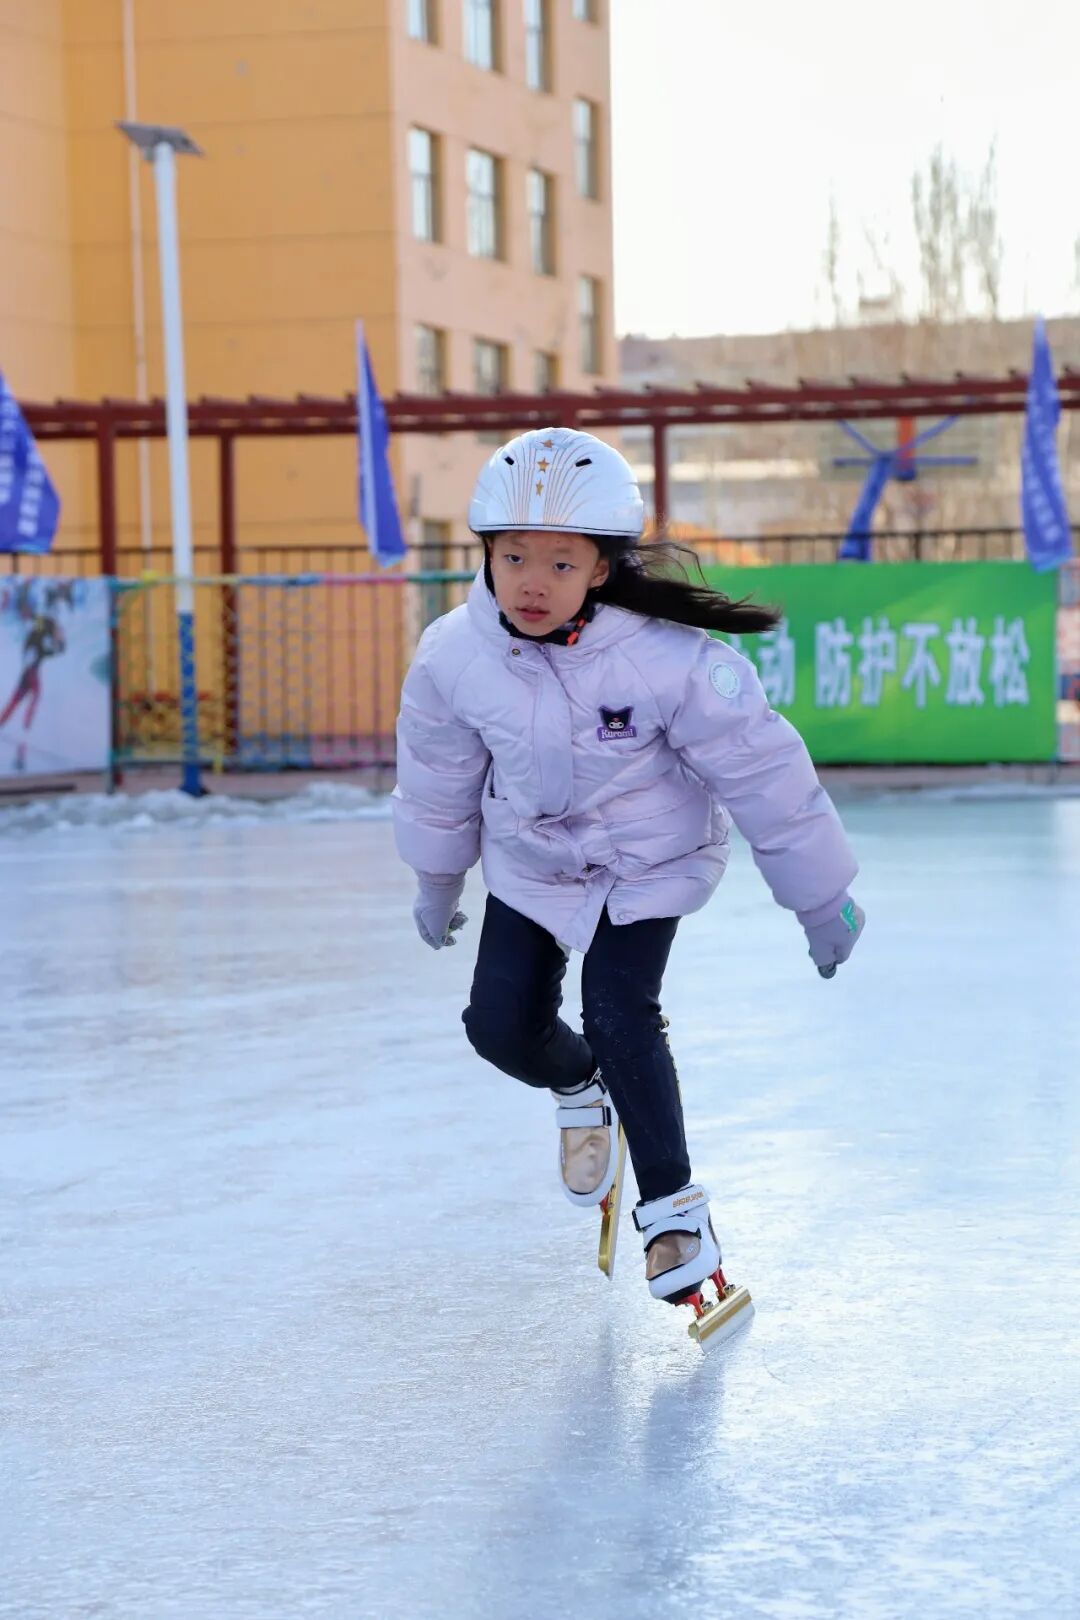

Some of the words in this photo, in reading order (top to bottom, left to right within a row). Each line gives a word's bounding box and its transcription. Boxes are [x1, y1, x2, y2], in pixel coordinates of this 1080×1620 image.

[730, 618, 796, 707] 动
[814, 615, 1030, 708] 防护不放松
[601, 728, 634, 739] Kuromi
